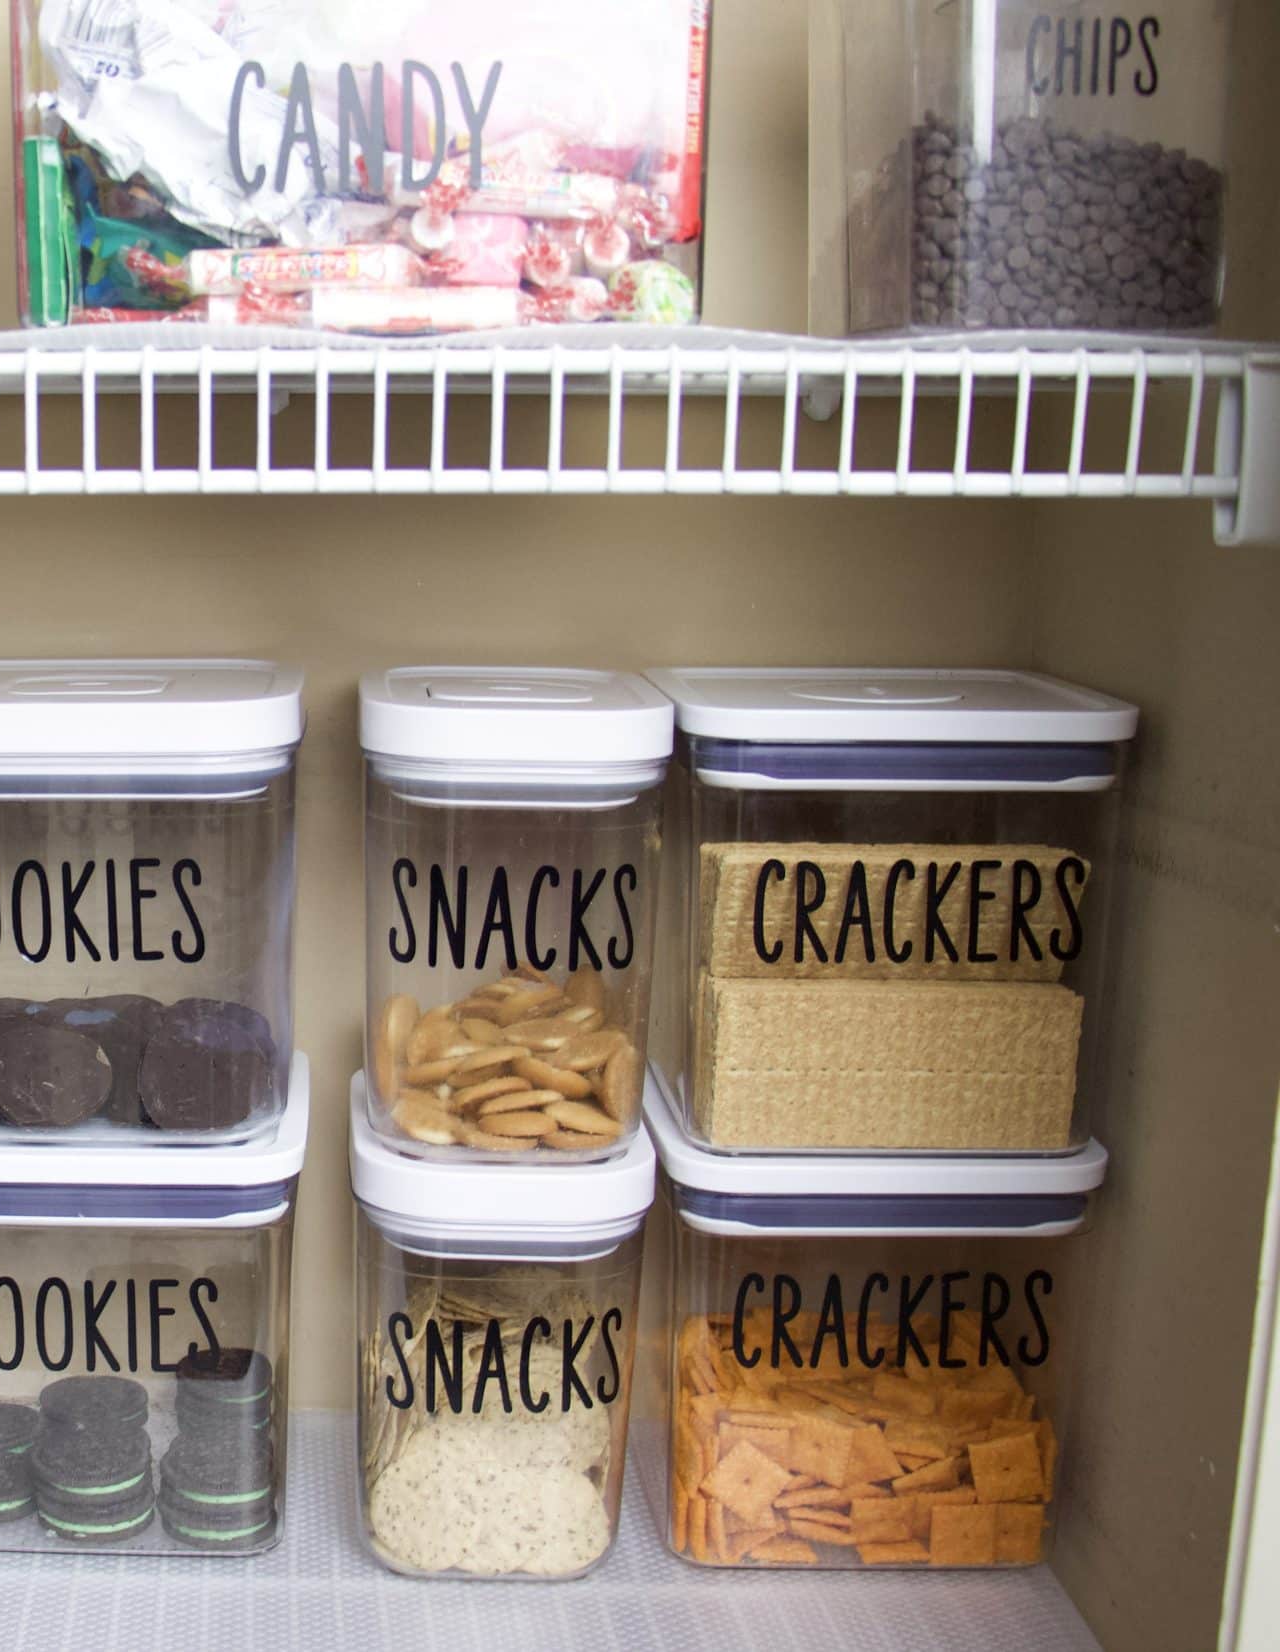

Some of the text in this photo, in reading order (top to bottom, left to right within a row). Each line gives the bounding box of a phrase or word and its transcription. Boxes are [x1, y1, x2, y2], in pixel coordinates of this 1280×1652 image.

[1026, 15, 1161, 97] CHIPS
[228, 60, 503, 195] CANDY
[389, 857, 638, 972] SNACKS
[752, 856, 1086, 964] CRACKERS
[385, 1306, 623, 1414] SNACKS
[732, 1269, 1054, 1369] CRACKERS
